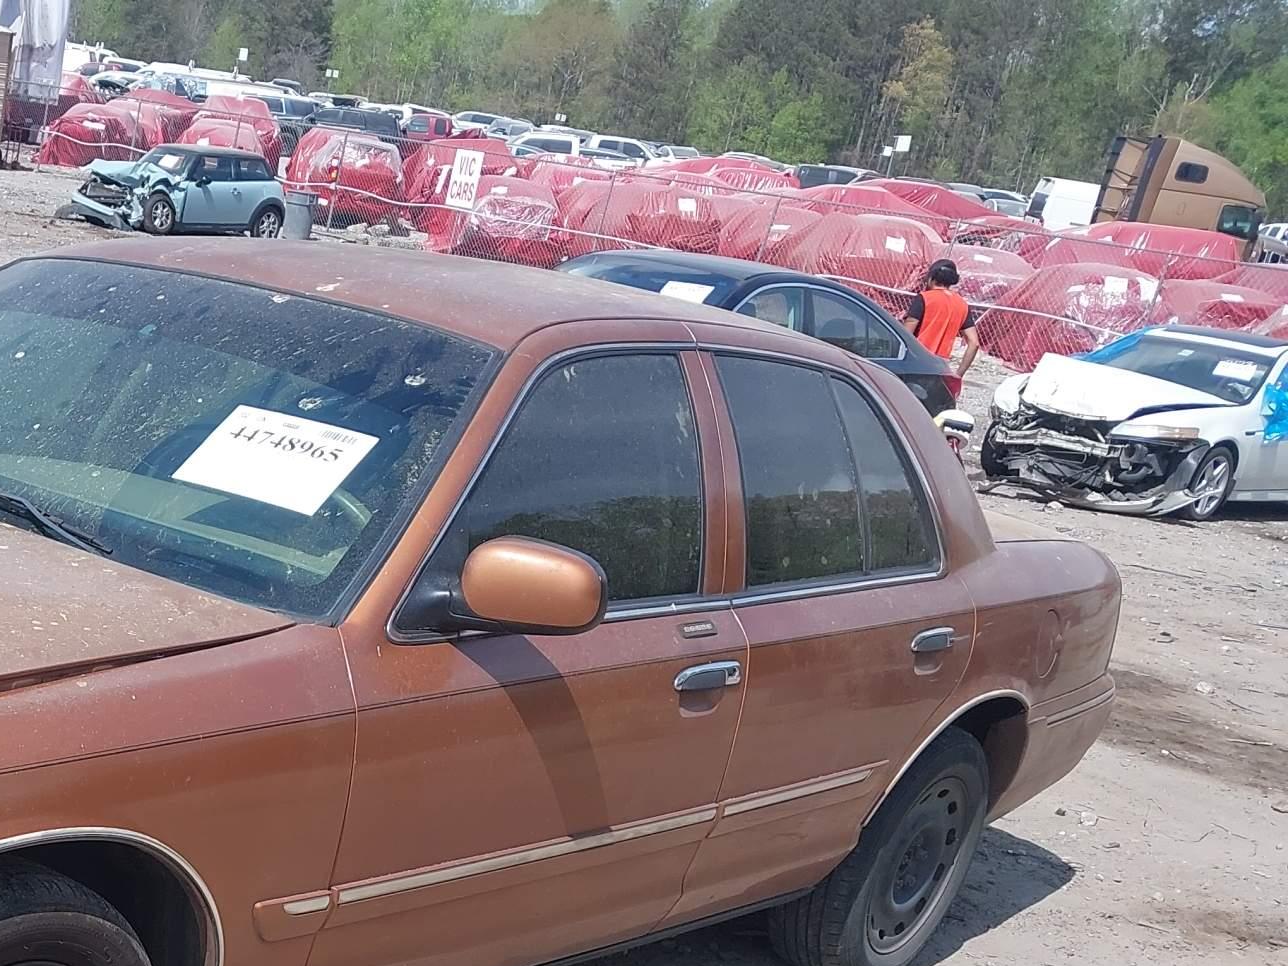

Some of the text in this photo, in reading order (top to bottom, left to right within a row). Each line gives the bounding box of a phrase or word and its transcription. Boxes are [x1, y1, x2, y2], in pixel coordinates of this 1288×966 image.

[459, 156, 476, 177] VIC
[450, 180, 475, 202] CARS
[229, 426, 344, 462] 44748965
